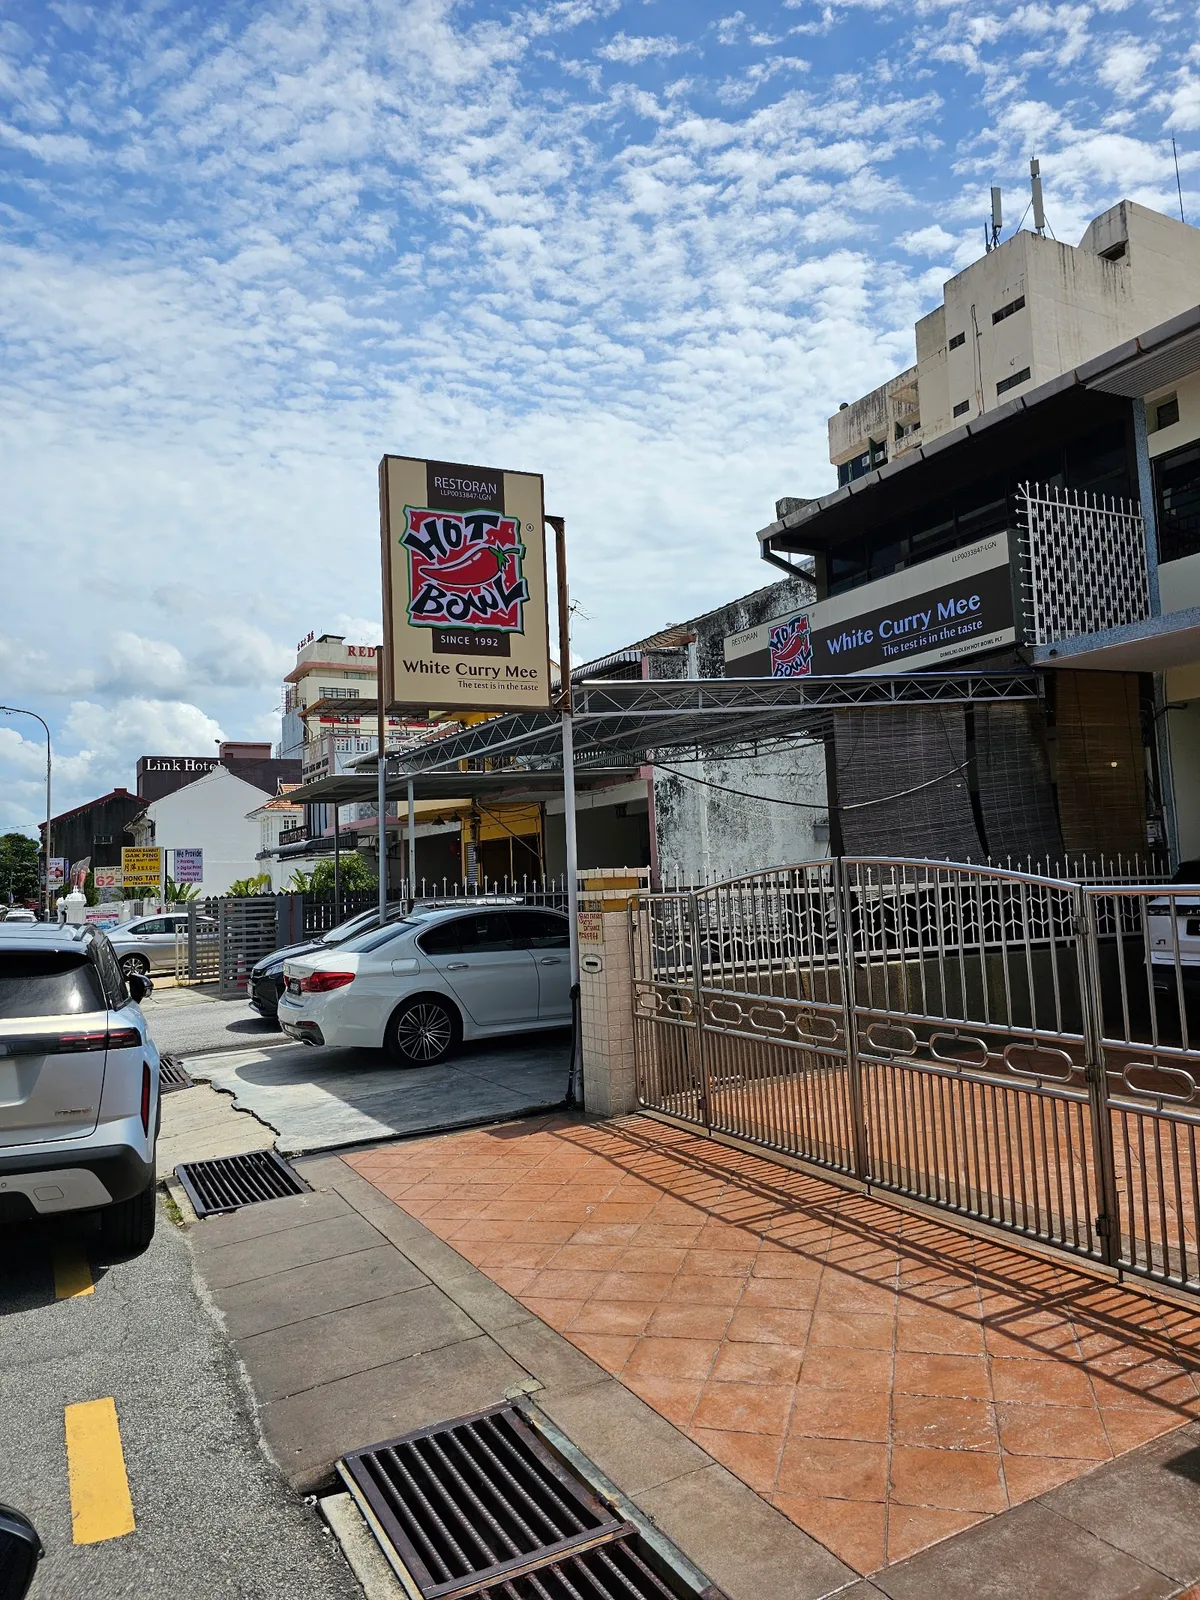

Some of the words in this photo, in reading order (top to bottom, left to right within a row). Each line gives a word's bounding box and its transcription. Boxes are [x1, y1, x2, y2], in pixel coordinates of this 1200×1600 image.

[434, 477, 497, 495] RESTORAN
[440, 490, 492, 501] LLP0033847-LGN
[403, 514, 500, 561] HOT
[410, 574, 525, 621] BOWL
[826, 629, 874, 655] White
[878, 609, 932, 638] Curry
[937, 594, 981, 621] Mee
[440, 635, 470, 645] SINCE
[475, 637, 499, 647] 1992
[731, 631, 758, 647] RESTORAN
[769, 616, 801, 651] HOT
[882, 645, 899, 657] The
[900, 639, 918, 652] test
[919, 636, 927, 646] is
[929, 632, 938, 643] in
[940, 626, 956, 640] the
[957, 620, 983, 634] taste
[980, 639, 994, 647] BOWL
[347, 645, 376, 658] RED
[402, 659, 451, 675] White
[455, 663, 501, 680] Curry
[505, 665, 538, 679] Mee
[774, 646, 813, 677] BOWL
[458, 680, 473, 689] The
[474, 682, 489, 690] test
[490, 682, 497, 690] is
[498, 682, 505, 690] in
[506, 682, 519, 691] the
[520, 683, 539, 691] taste
[146, 759, 181, 771] Link
[184, 849, 202, 858] Provide
[95, 875, 115, 887] 62
